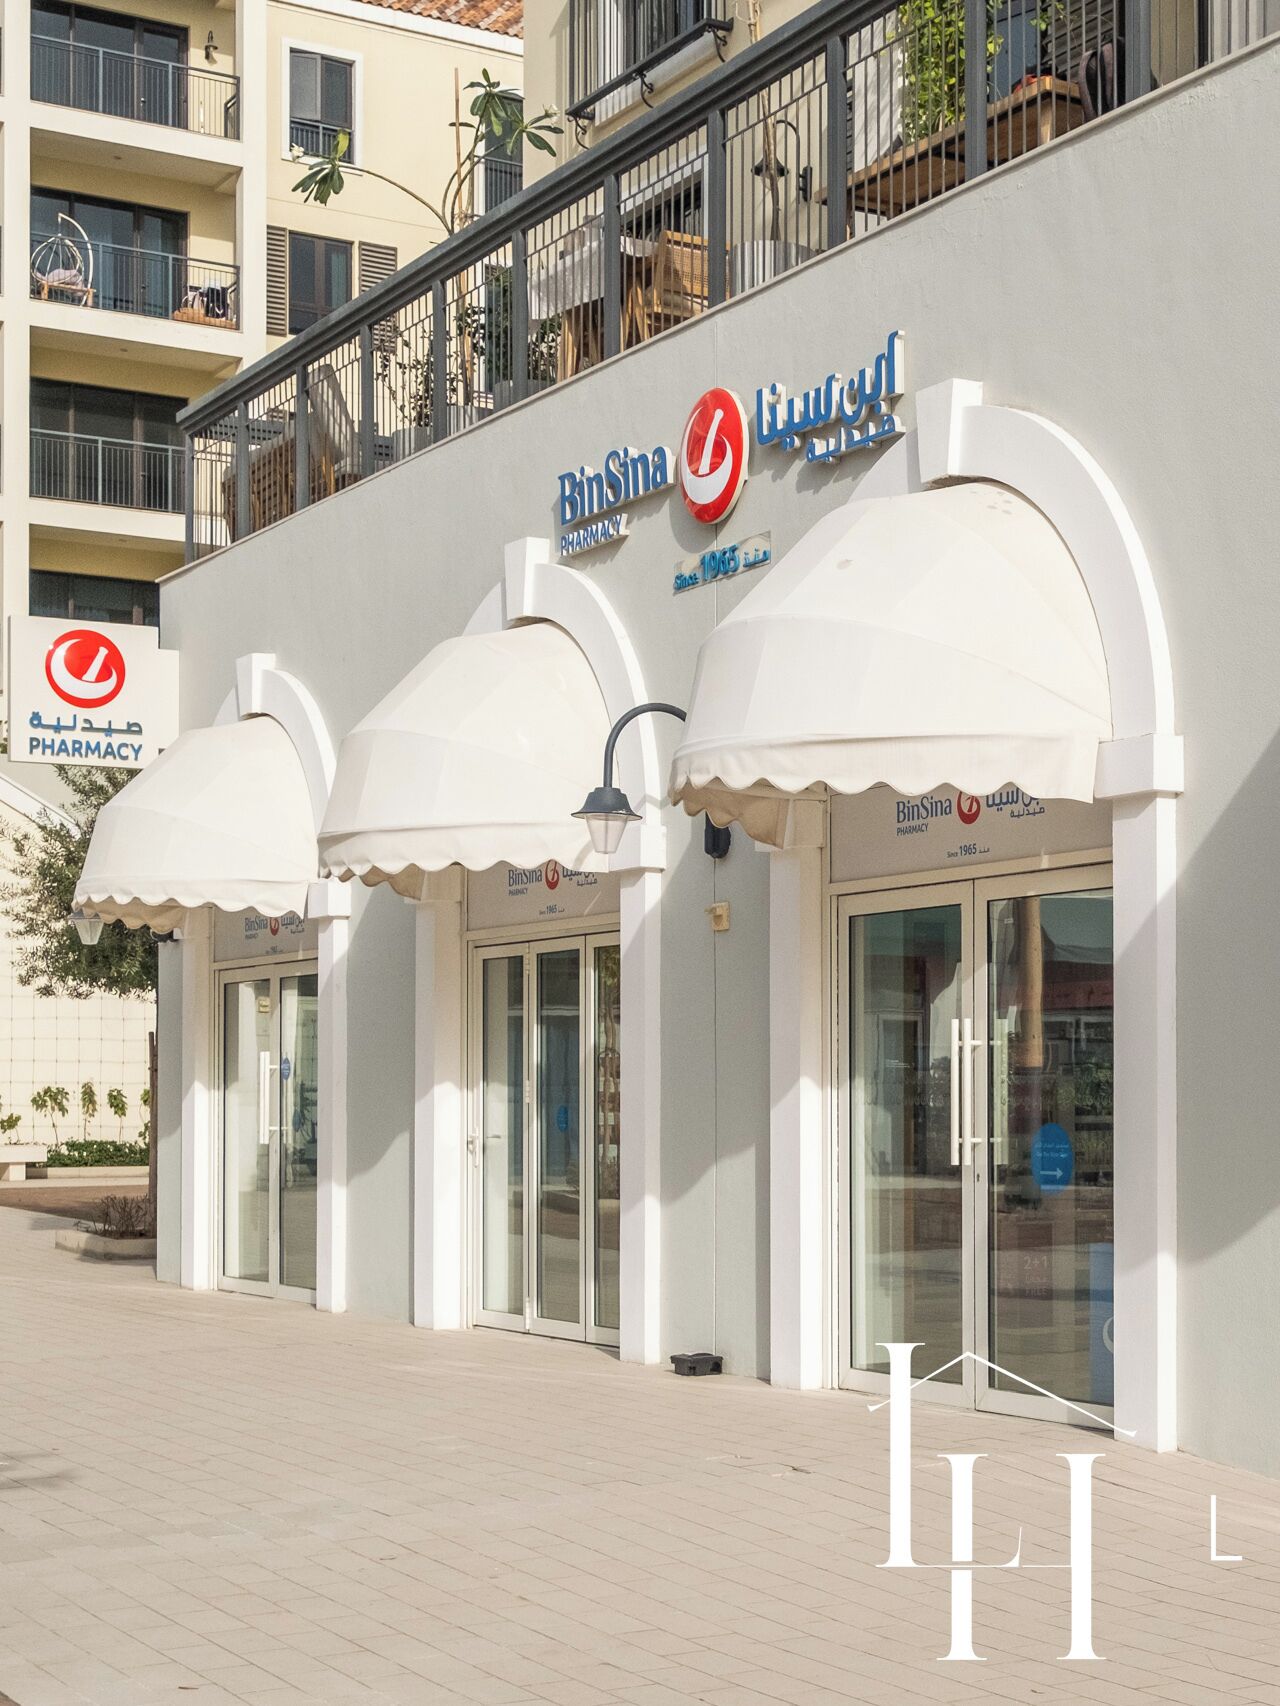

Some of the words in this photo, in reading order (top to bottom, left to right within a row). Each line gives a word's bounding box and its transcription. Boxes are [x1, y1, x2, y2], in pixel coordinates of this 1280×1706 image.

[838, 330, 902, 425] ابن
[756, 373, 839, 450] سينا
[558, 446, 673, 526] BinSina
[560, 513, 628, 557] PHARMACY
[700, 544, 739, 581] 1965
[29, 711, 143, 737] صيدلية
[29, 736, 143, 761] PHARMACY
[896, 796, 953, 824] BinSina
[896, 822, 929, 837] PHARMACY
[959, 843, 977, 857] 1965
